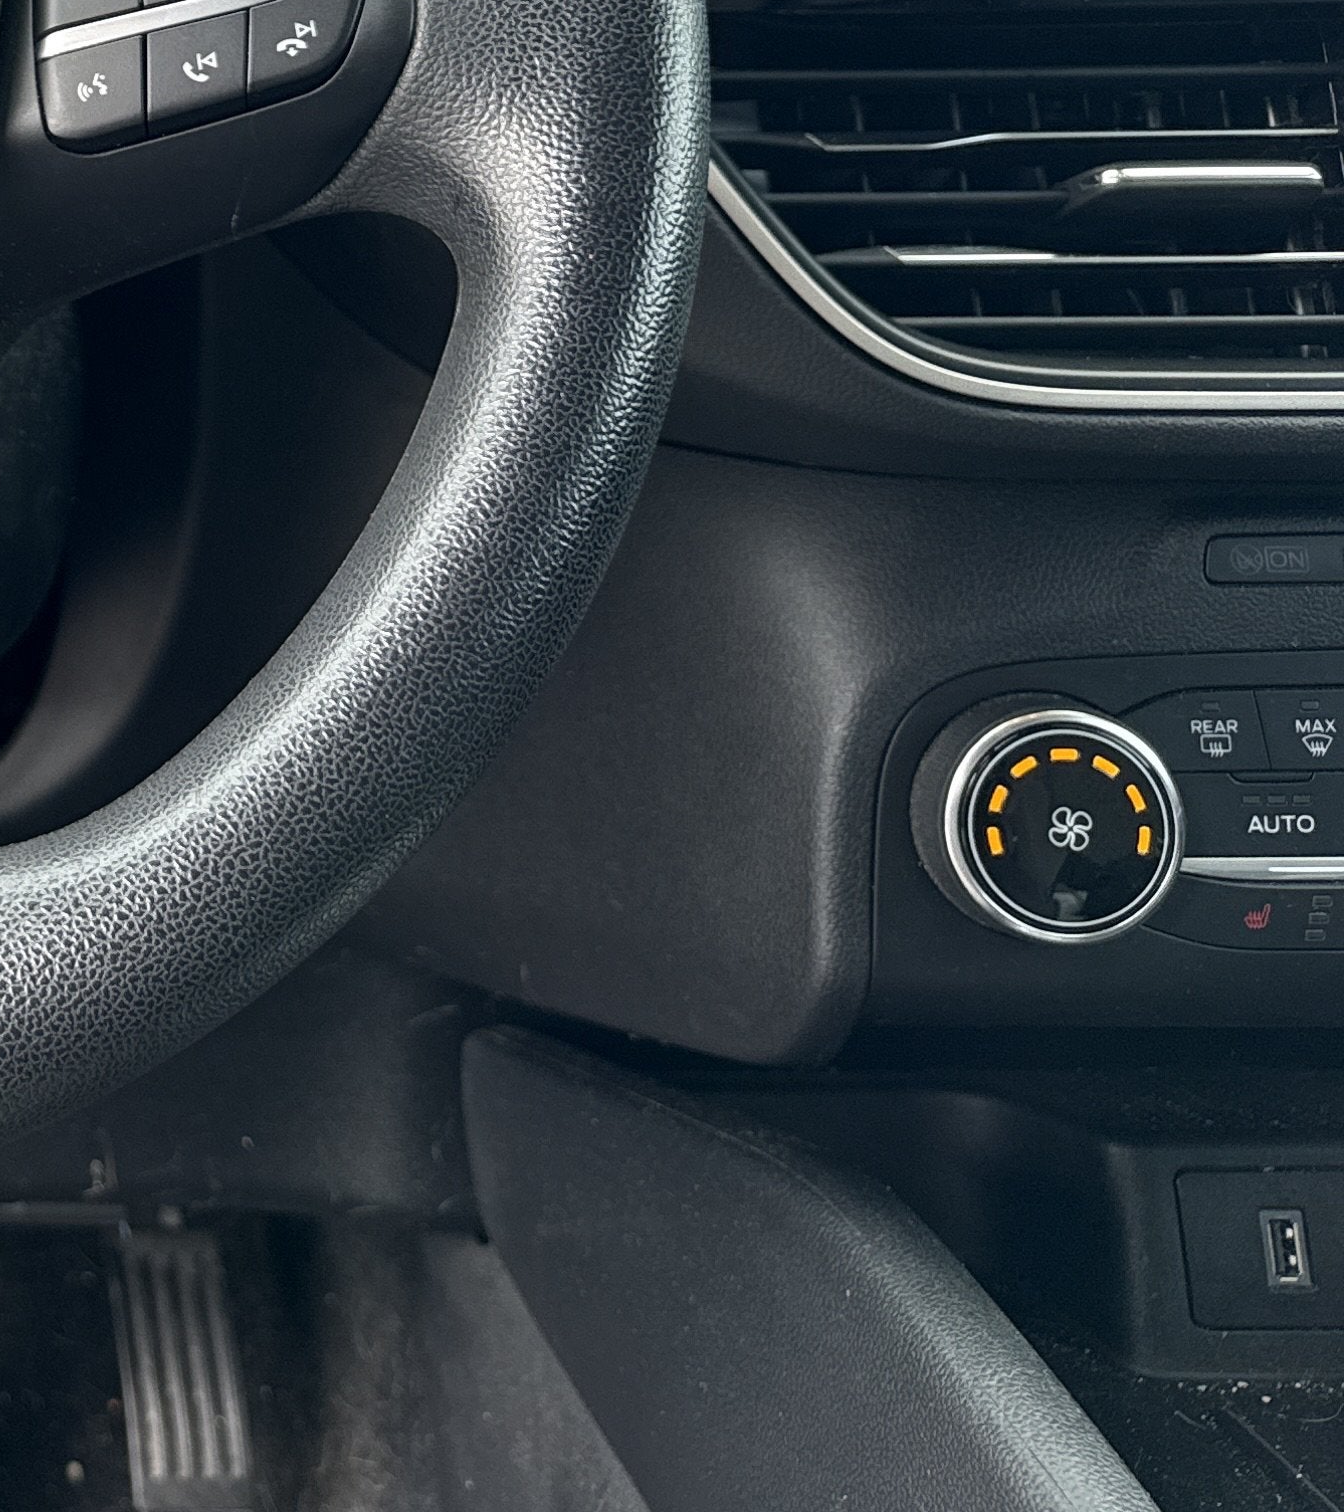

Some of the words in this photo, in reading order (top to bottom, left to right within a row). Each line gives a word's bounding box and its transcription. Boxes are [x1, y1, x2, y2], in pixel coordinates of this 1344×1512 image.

[1269, 550, 1305, 569] ON
[1190, 719, 1239, 734] REAR
[1295, 719, 1337, 734] MAX
[1247, 814, 1316, 834] AUTO
